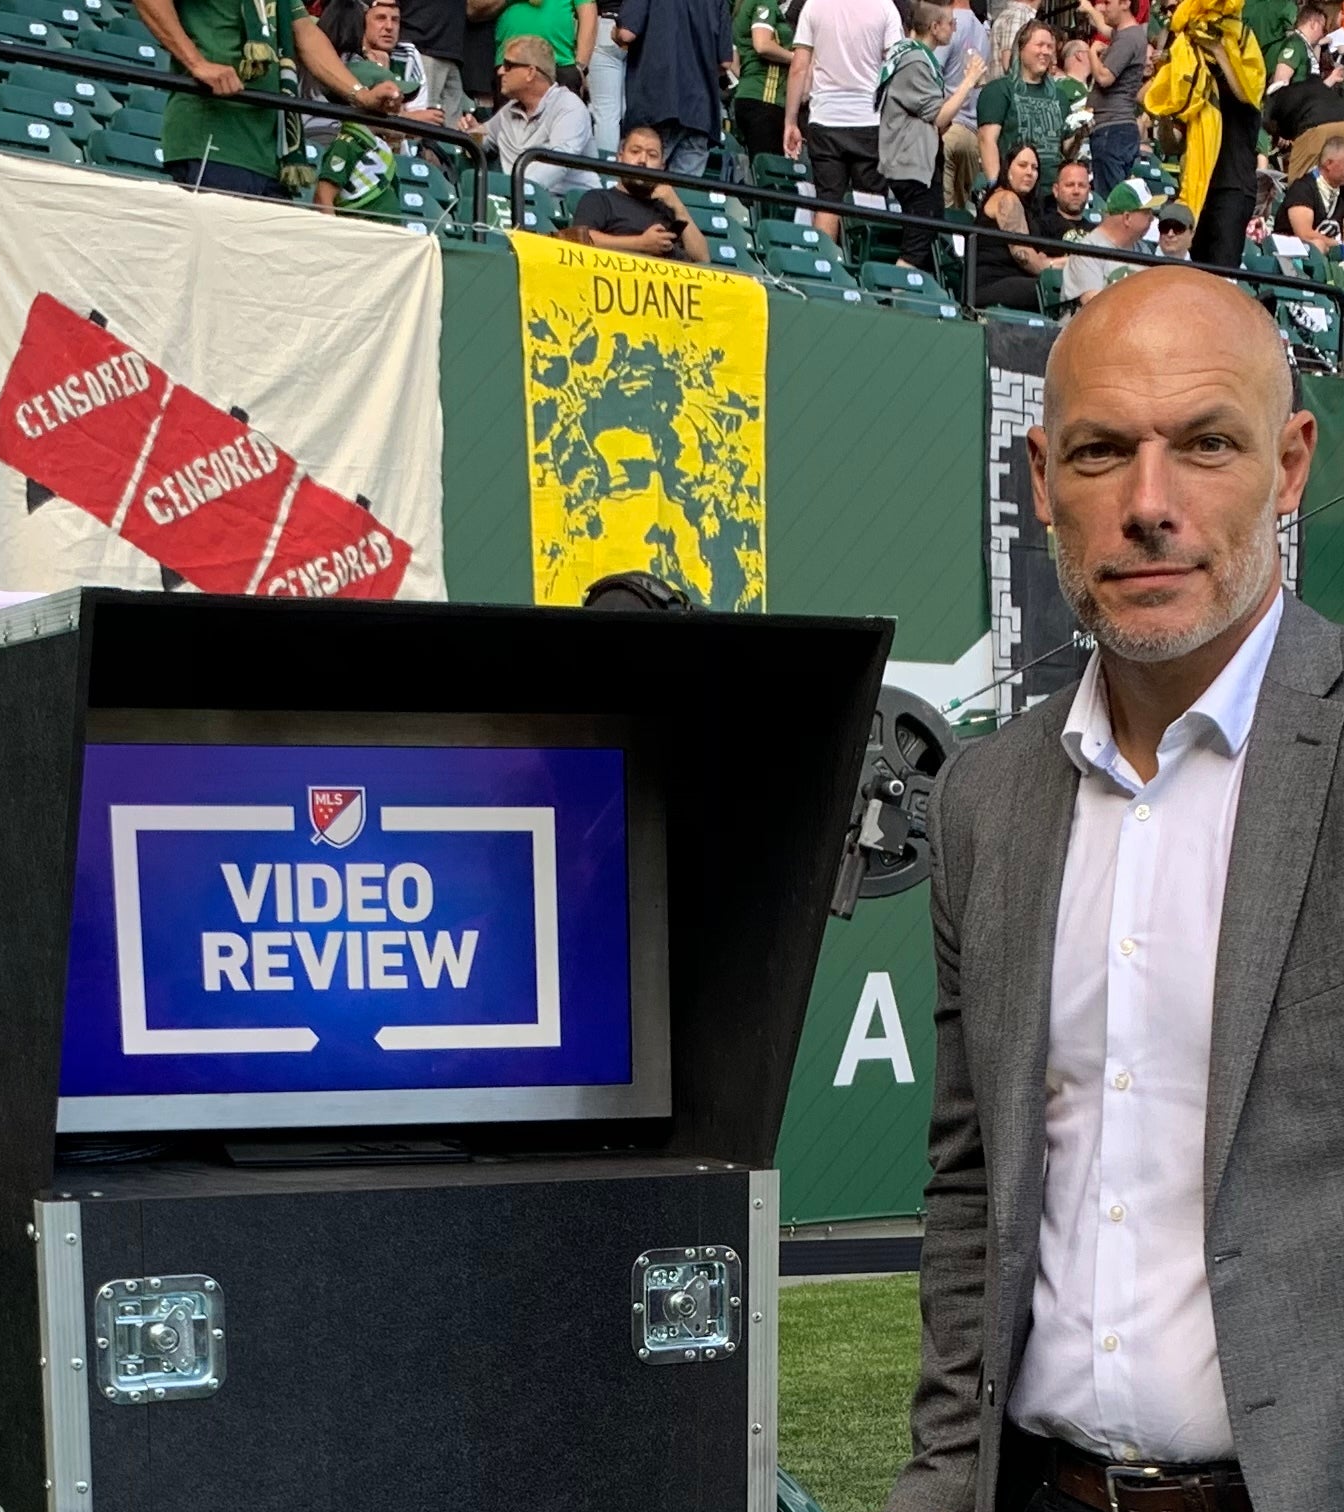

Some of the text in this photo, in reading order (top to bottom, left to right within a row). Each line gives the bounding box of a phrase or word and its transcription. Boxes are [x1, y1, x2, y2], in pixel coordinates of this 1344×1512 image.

[557, 247, 584, 267] IN
[593, 275, 703, 322] DUANE
[15, 351, 151, 440] CENSORED
[144, 430, 279, 526] CENSORED
[314, 792, 343, 806] MLS
[220, 862, 434, 924] VIDEO
[202, 929, 480, 992] REVIEW
